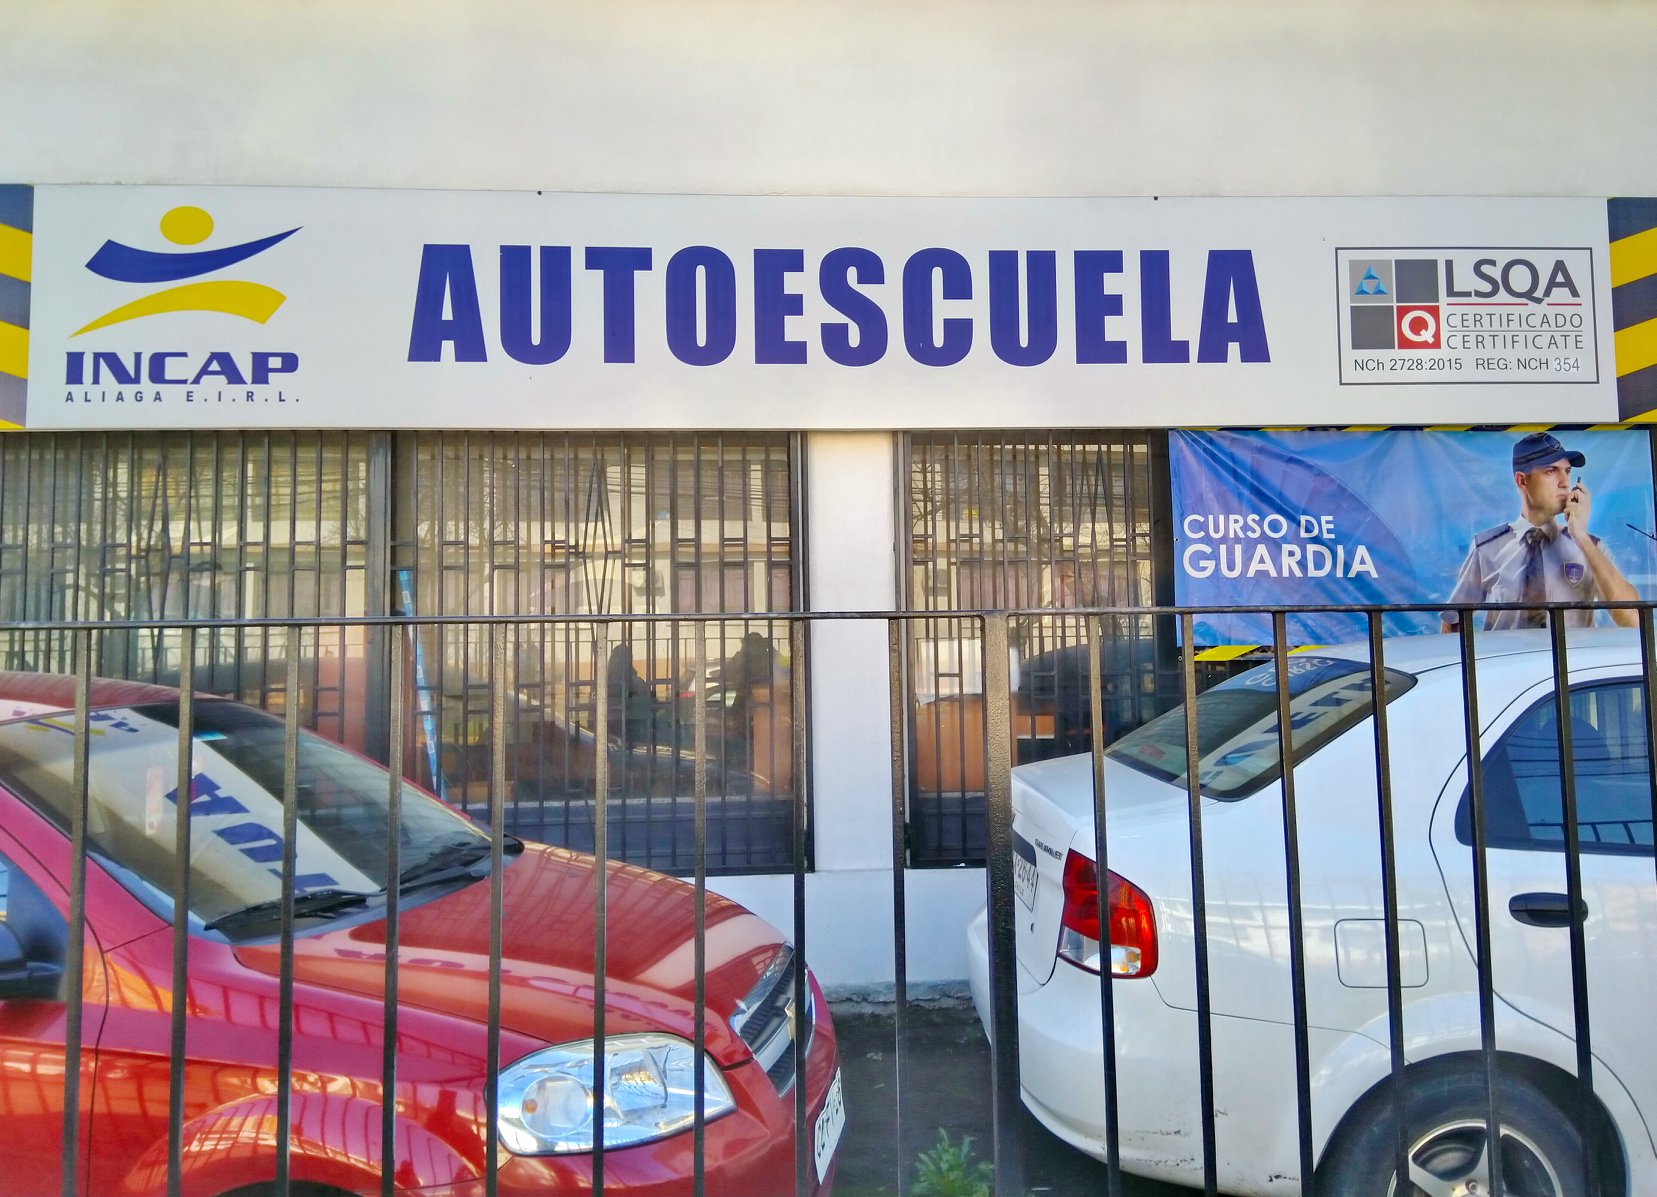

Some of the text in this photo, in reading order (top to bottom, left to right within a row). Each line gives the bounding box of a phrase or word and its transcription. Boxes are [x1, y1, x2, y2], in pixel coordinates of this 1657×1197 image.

[1445, 258, 1582, 305] LSQA
[407, 243, 1271, 367] AUTOESCUELA
[1401, 310, 1436, 344] Q
[1446, 312, 1584, 329] CERTIFICADO
[1446, 334, 1585, 350] CERTIFICATE
[65, 351, 299, 385] INCAP
[1354, 357, 1580, 372] NCh 2728:2015 REG: NCH 354
[65, 390, 301, 403] ALIAGA E.I.R.L.
[1183, 513, 1335, 539] CURSO DE
[1182, 543, 1379, 579] GUARDIA
